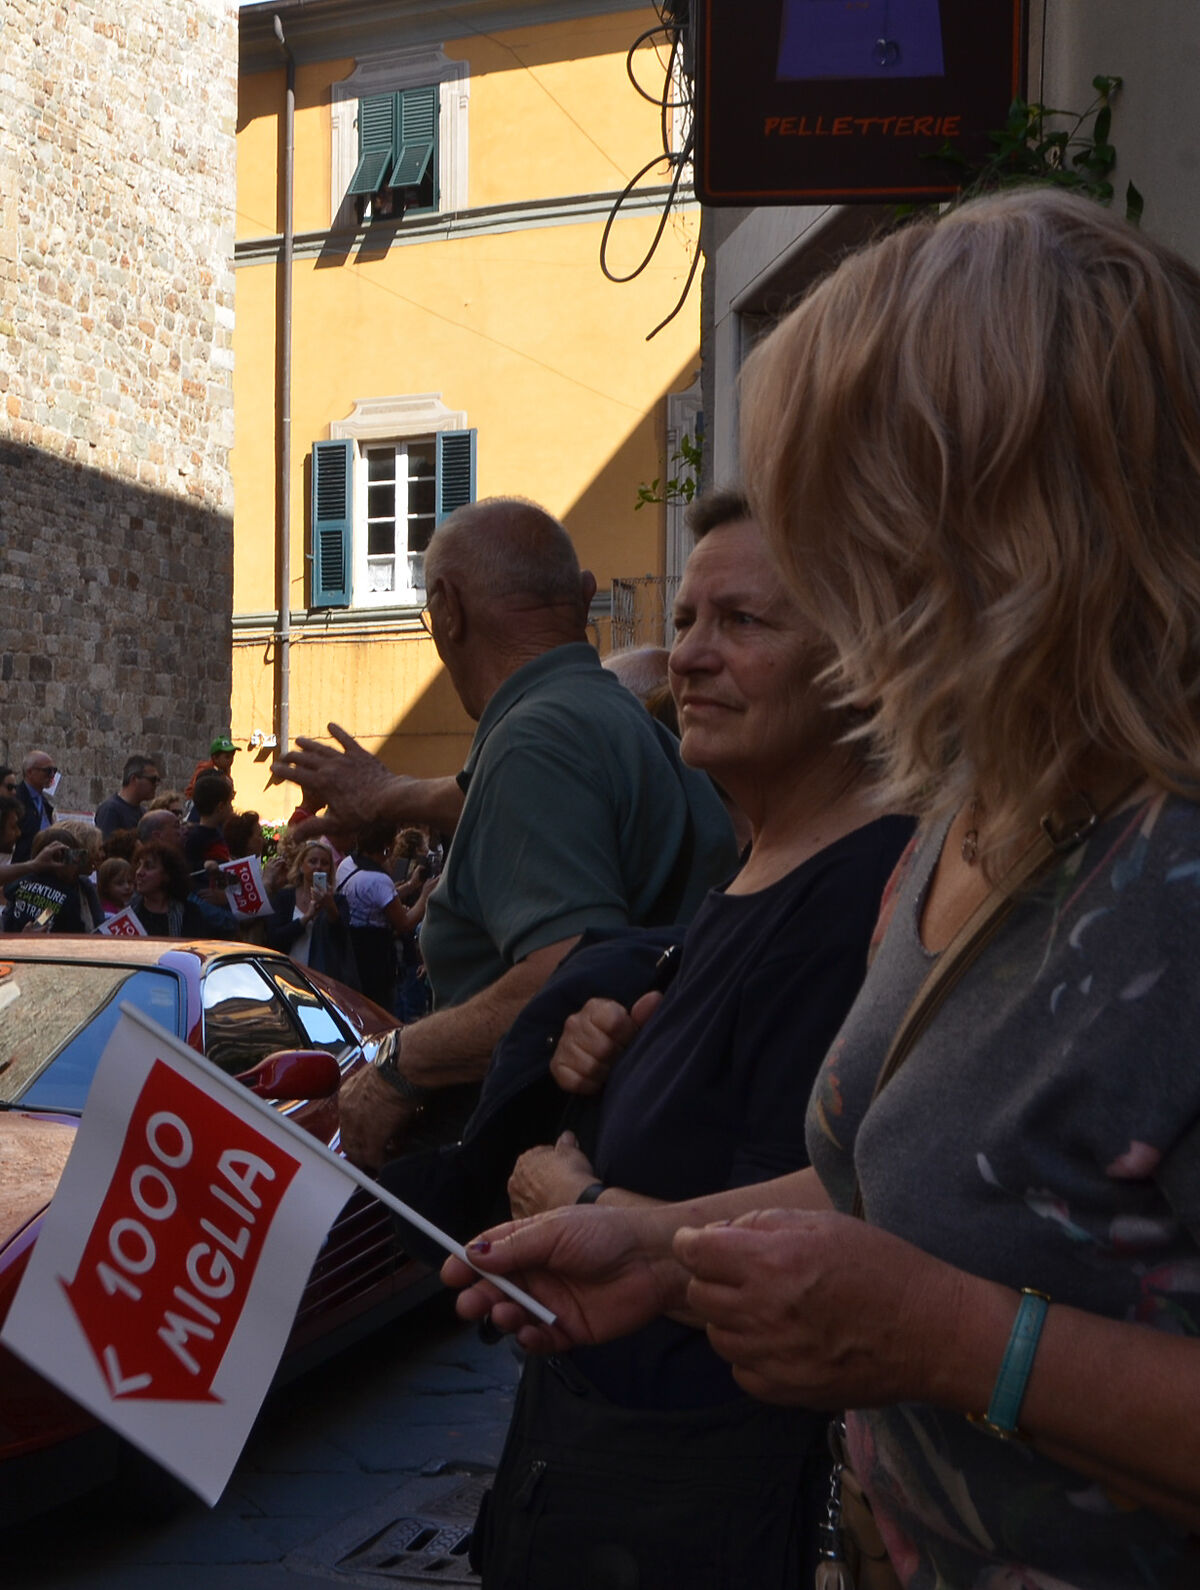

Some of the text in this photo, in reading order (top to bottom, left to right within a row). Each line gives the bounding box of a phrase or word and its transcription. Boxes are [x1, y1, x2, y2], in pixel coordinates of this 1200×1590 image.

[763, 115, 961, 137] PELLETTERIE
[96, 1111, 193, 1301] 1000
[156, 1148, 276, 1376] MIGLIA
